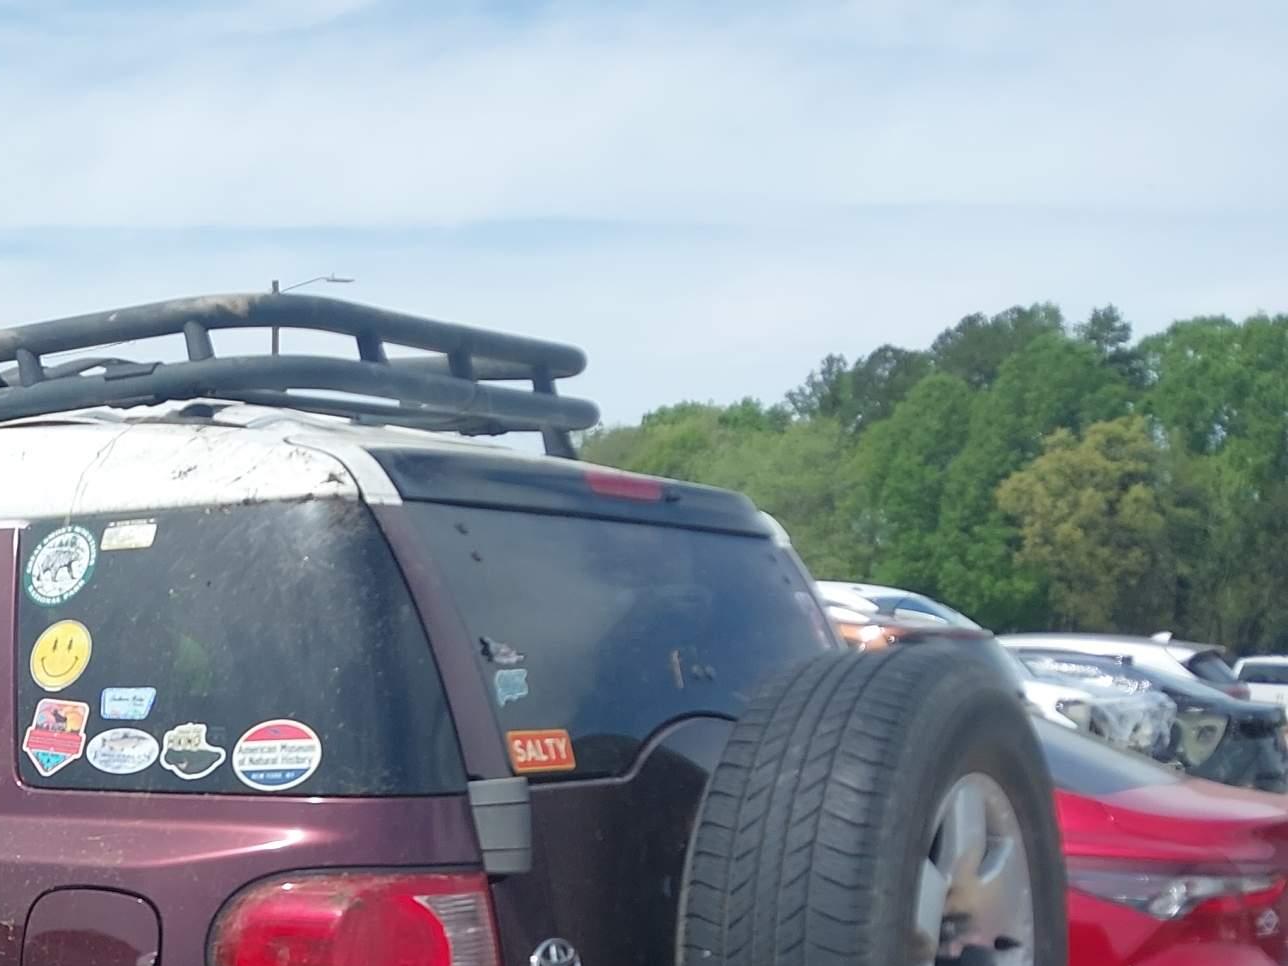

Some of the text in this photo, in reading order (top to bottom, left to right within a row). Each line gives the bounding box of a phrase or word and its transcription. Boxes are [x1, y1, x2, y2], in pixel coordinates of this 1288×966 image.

[238, 743, 316, 753] American Museum
[513, 737, 567, 762] SALTY
[249, 755, 278, 765] Natural
[280, 755, 313, 767] History
